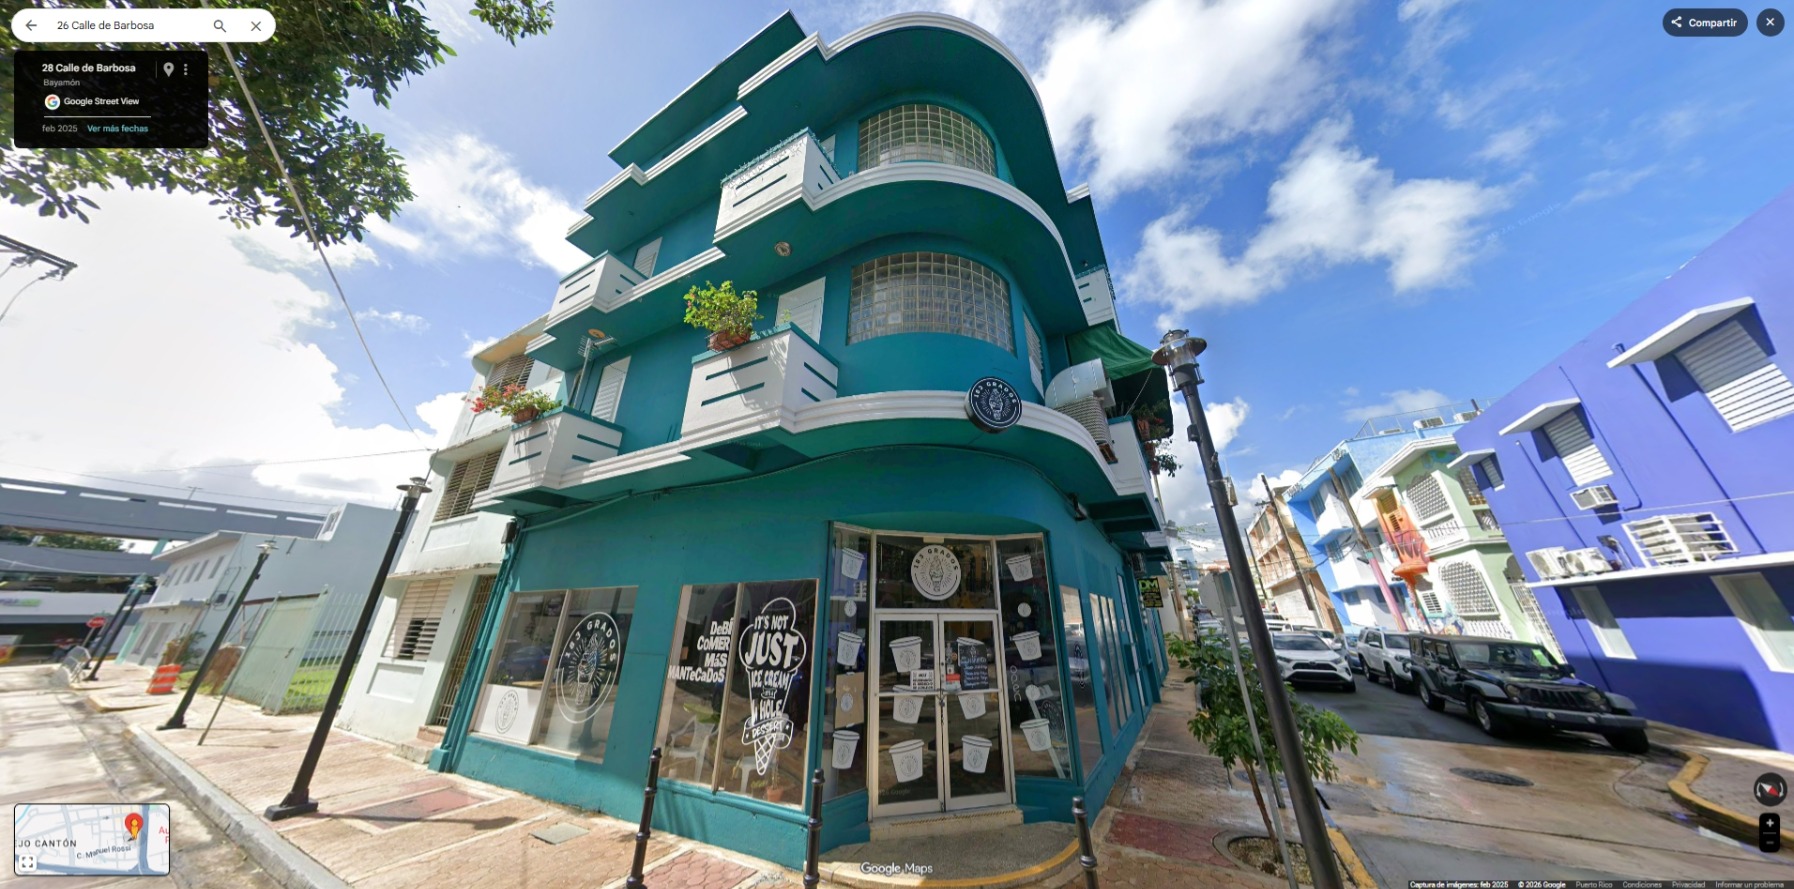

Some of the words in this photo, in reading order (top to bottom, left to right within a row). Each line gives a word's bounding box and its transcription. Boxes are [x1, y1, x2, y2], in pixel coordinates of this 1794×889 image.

[927, 547, 959, 571] GRADOS
[1138, 579, 1159, 593] DM
[753, 615, 770, 630] IT'S
[771, 615, 789, 630] NOT
[586, 619, 617, 662] GRADOS
[744, 631, 800, 669] JUST
[751, 670, 763, 688] ICE
[763, 670, 790, 691] CREAM
[752, 720, 785, 739] DESSERT
